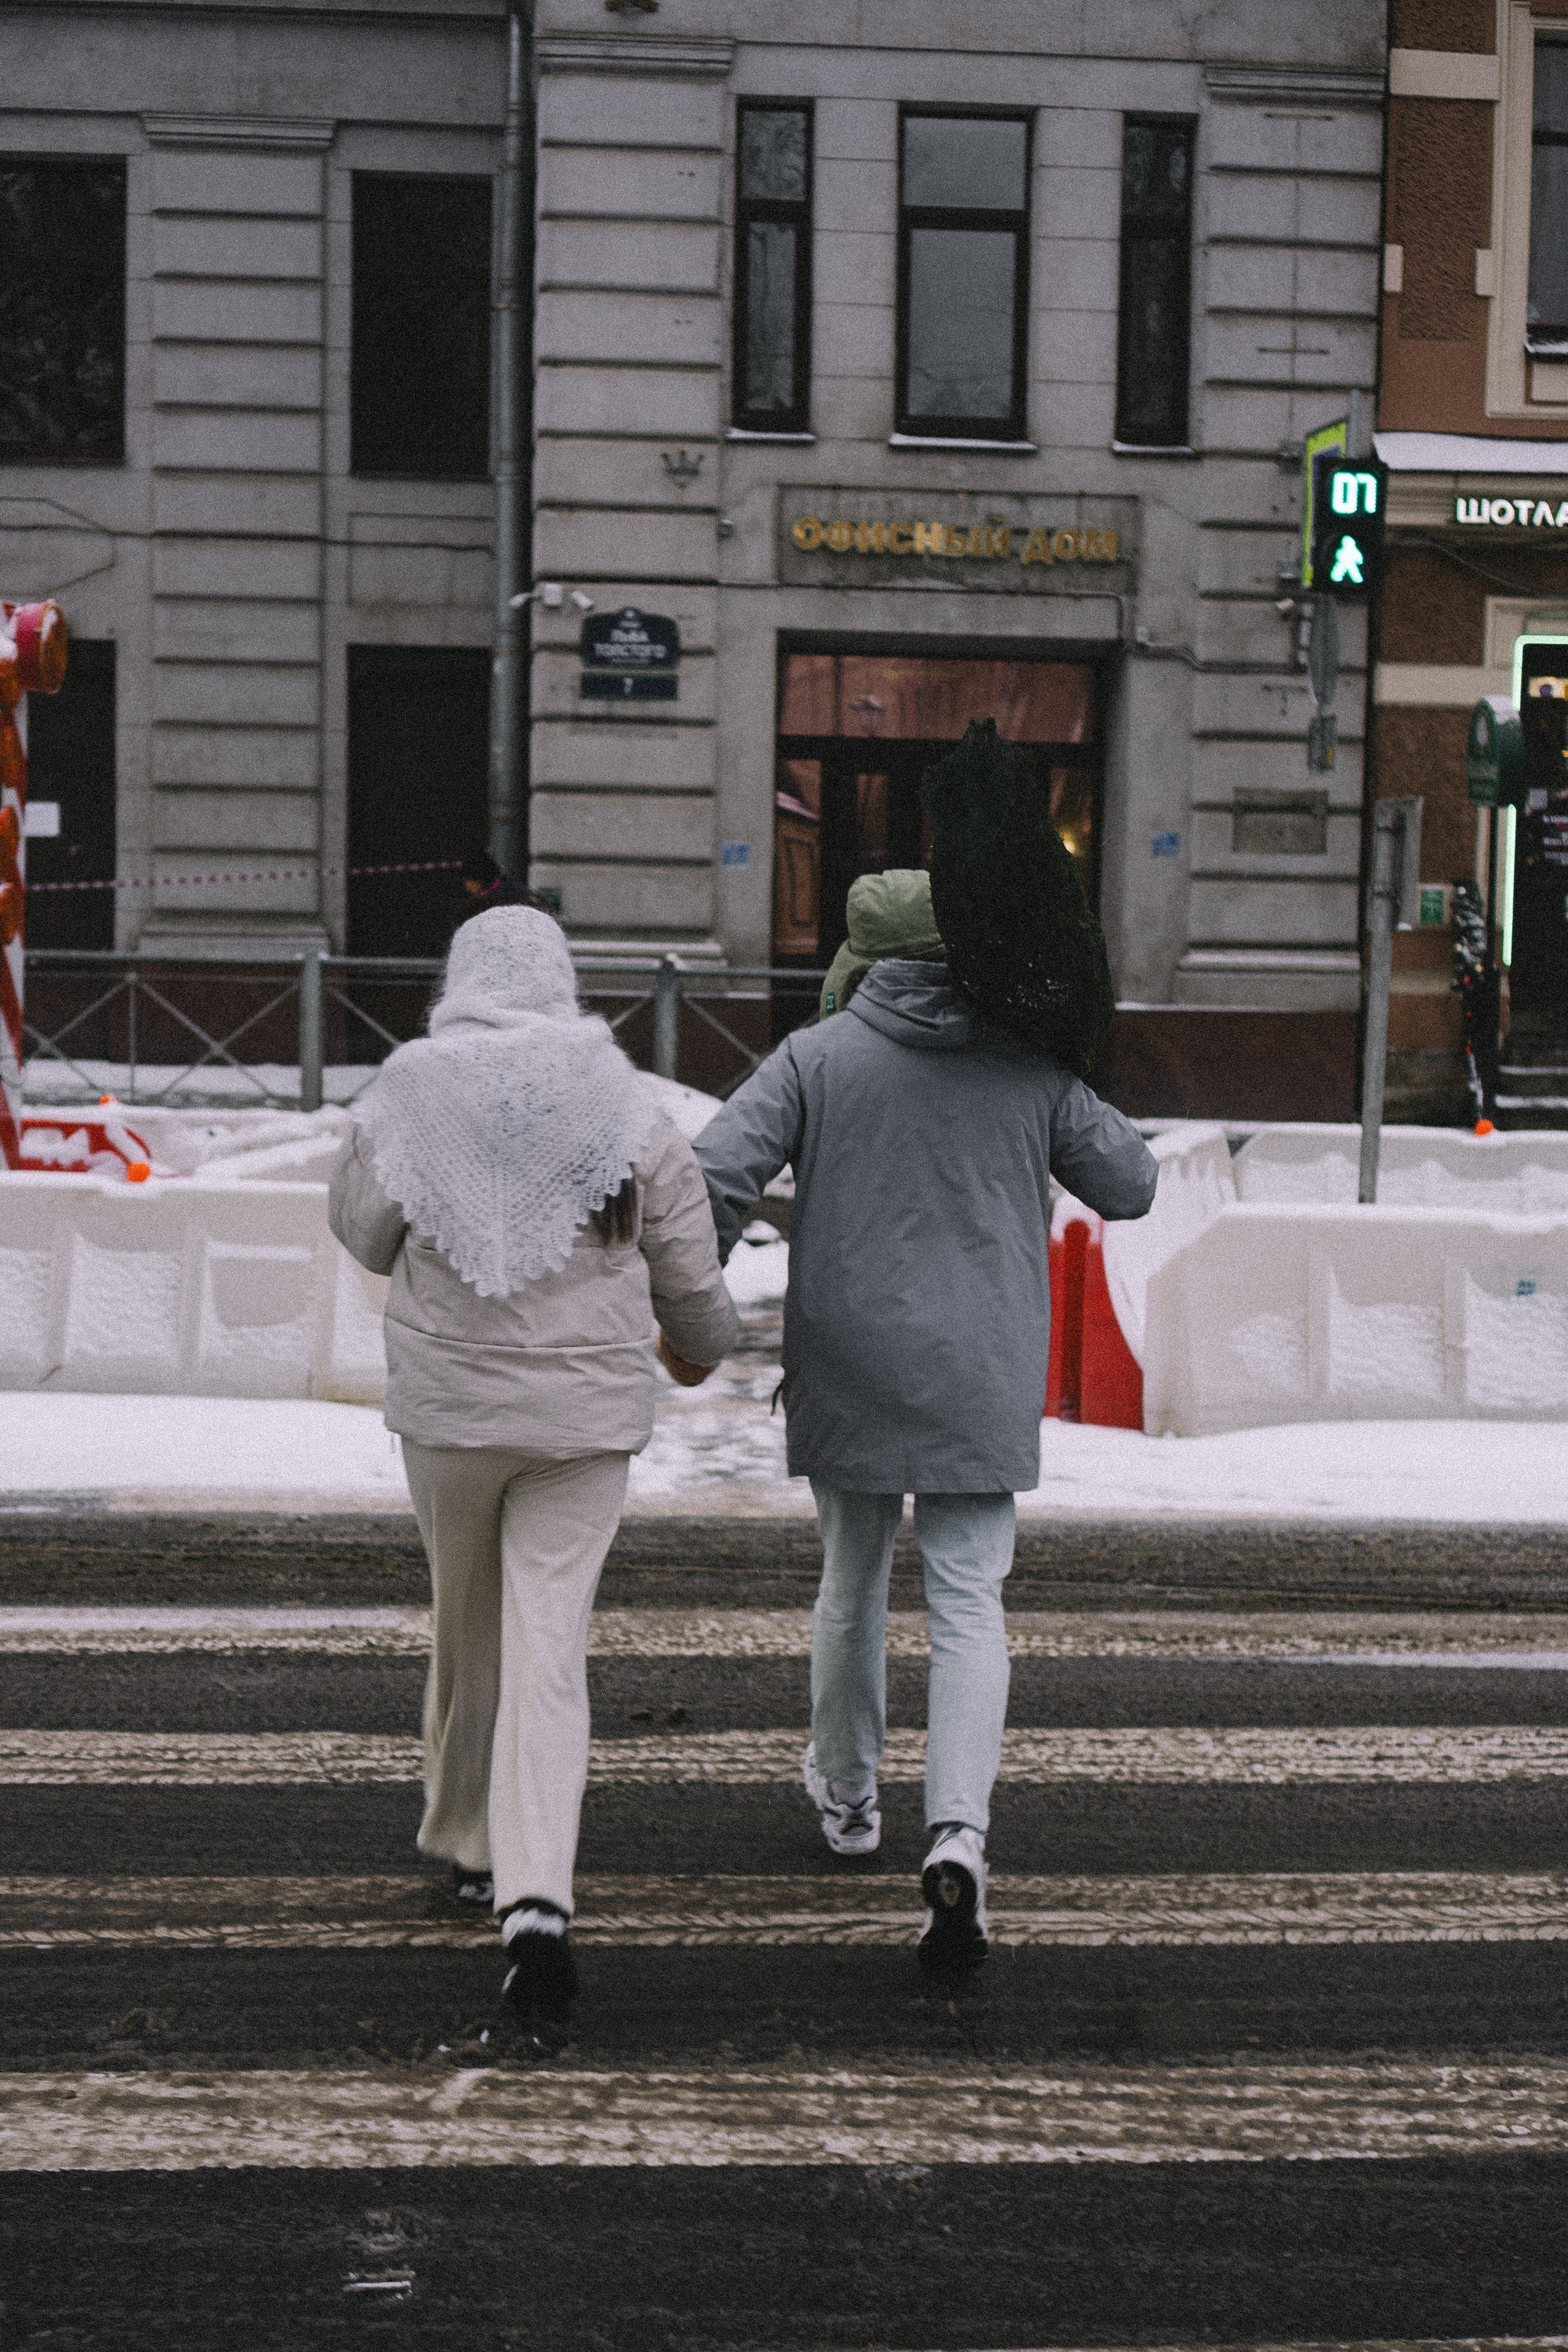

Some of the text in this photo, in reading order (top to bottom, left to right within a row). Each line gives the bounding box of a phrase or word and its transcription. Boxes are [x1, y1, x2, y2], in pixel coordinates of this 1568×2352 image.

[1332, 471, 1378, 514] 07
[793, 513, 1118, 565] ОФИСНЫЙ ДОМ
